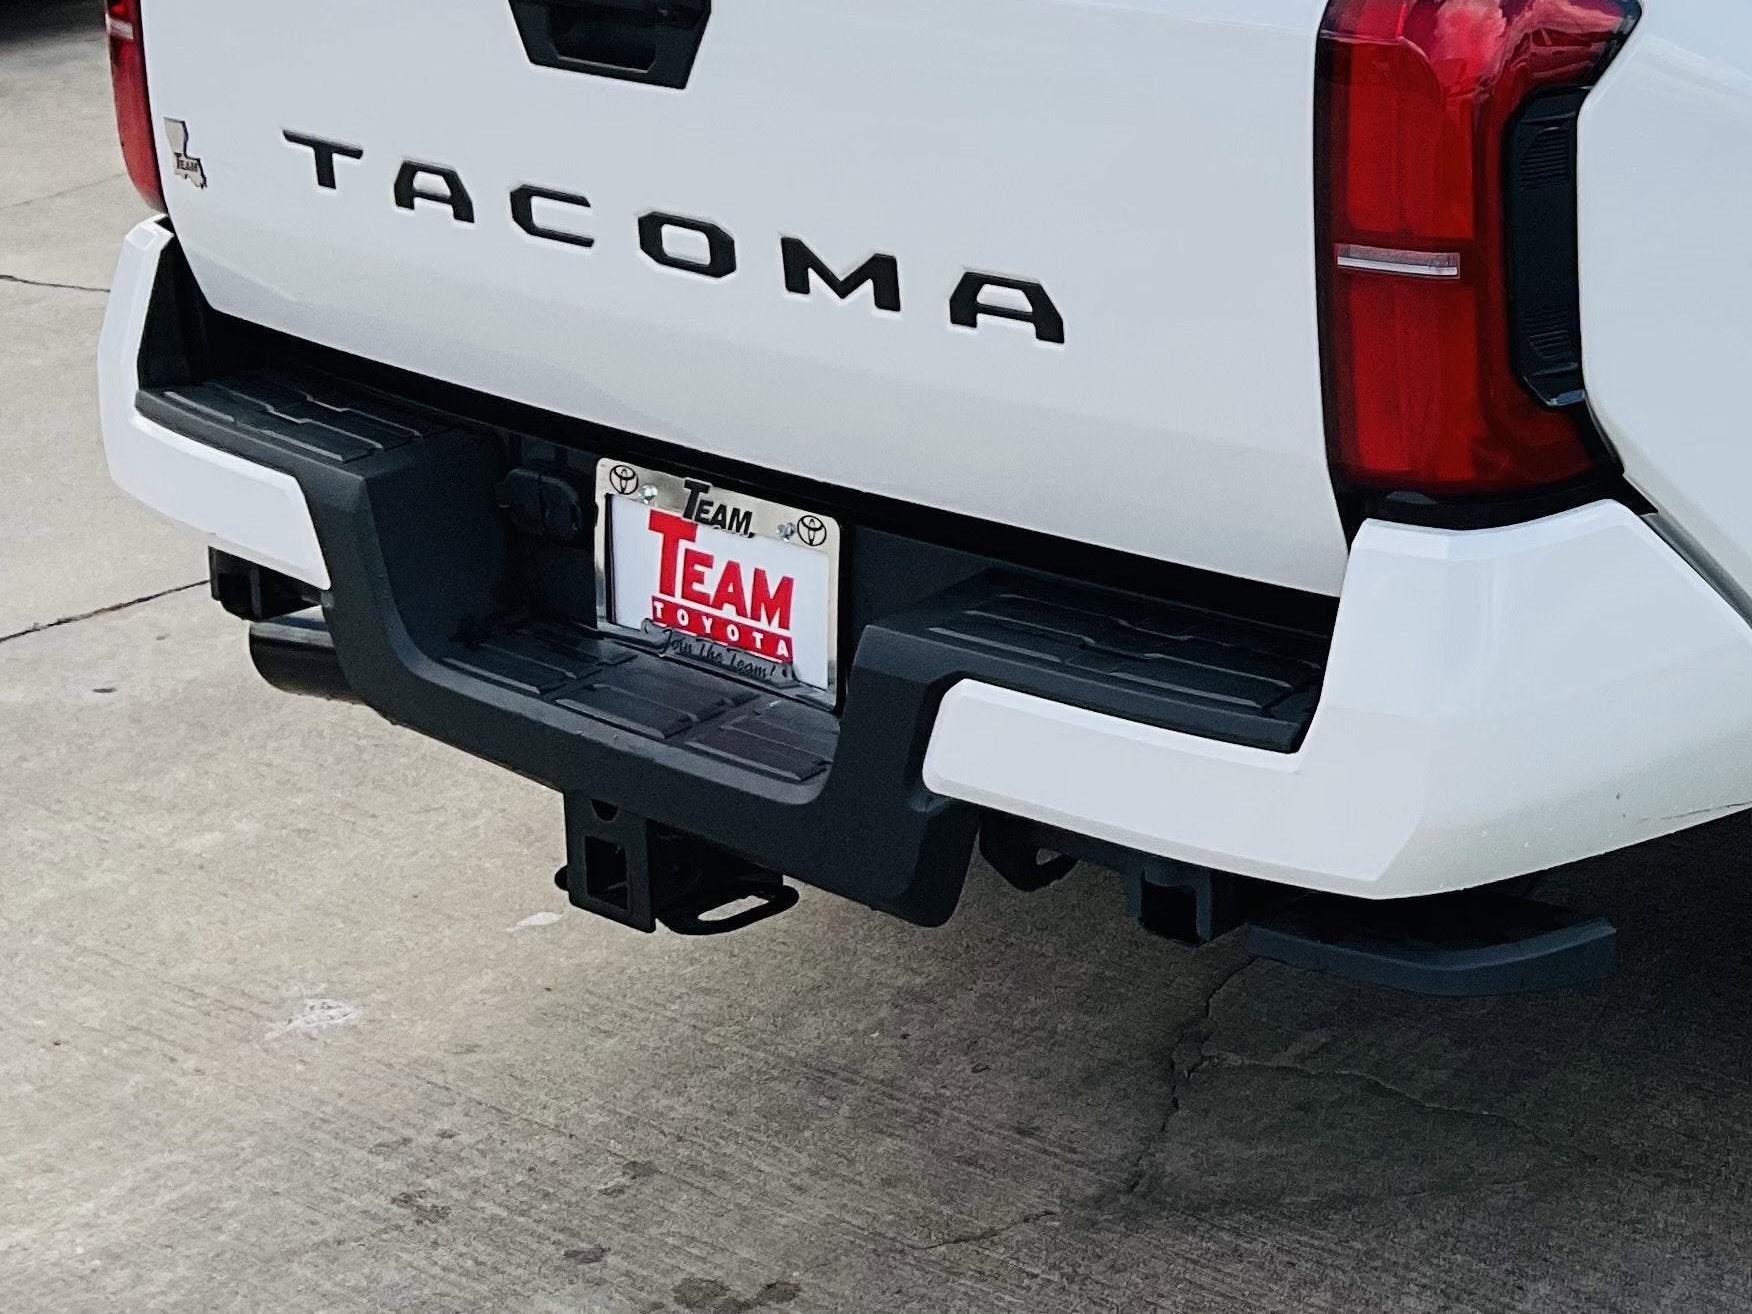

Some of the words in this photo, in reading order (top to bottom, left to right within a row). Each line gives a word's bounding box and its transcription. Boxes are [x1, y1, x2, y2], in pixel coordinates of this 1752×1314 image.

[282, 129, 1066, 345] TACOMA
[648, 509, 794, 631] TEAM
[653, 600, 790, 659] TOYOTA
